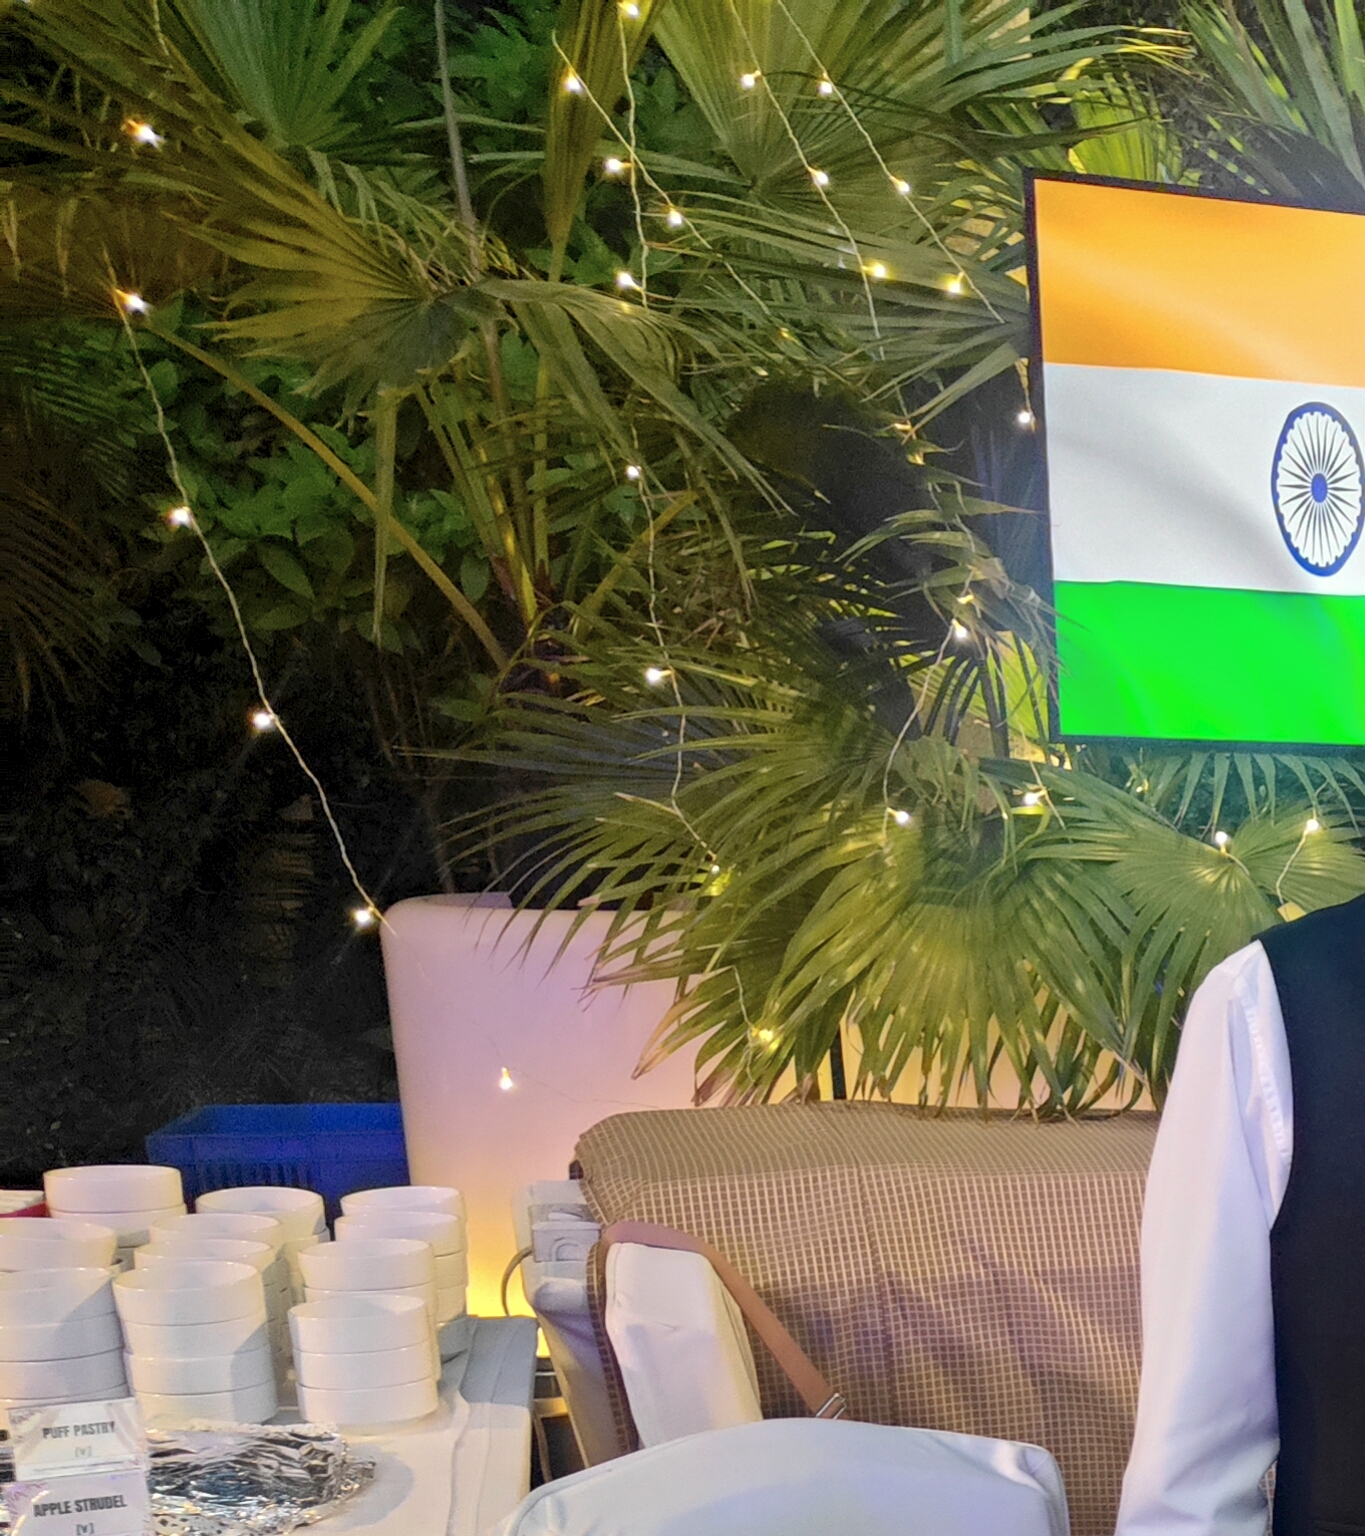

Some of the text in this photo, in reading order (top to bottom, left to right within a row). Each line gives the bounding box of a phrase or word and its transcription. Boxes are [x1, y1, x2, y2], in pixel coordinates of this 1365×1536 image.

[43, 1421, 115, 1439] PUFF PASTRY
[34, 1495, 128, 1517] APPLE STRUDEL
